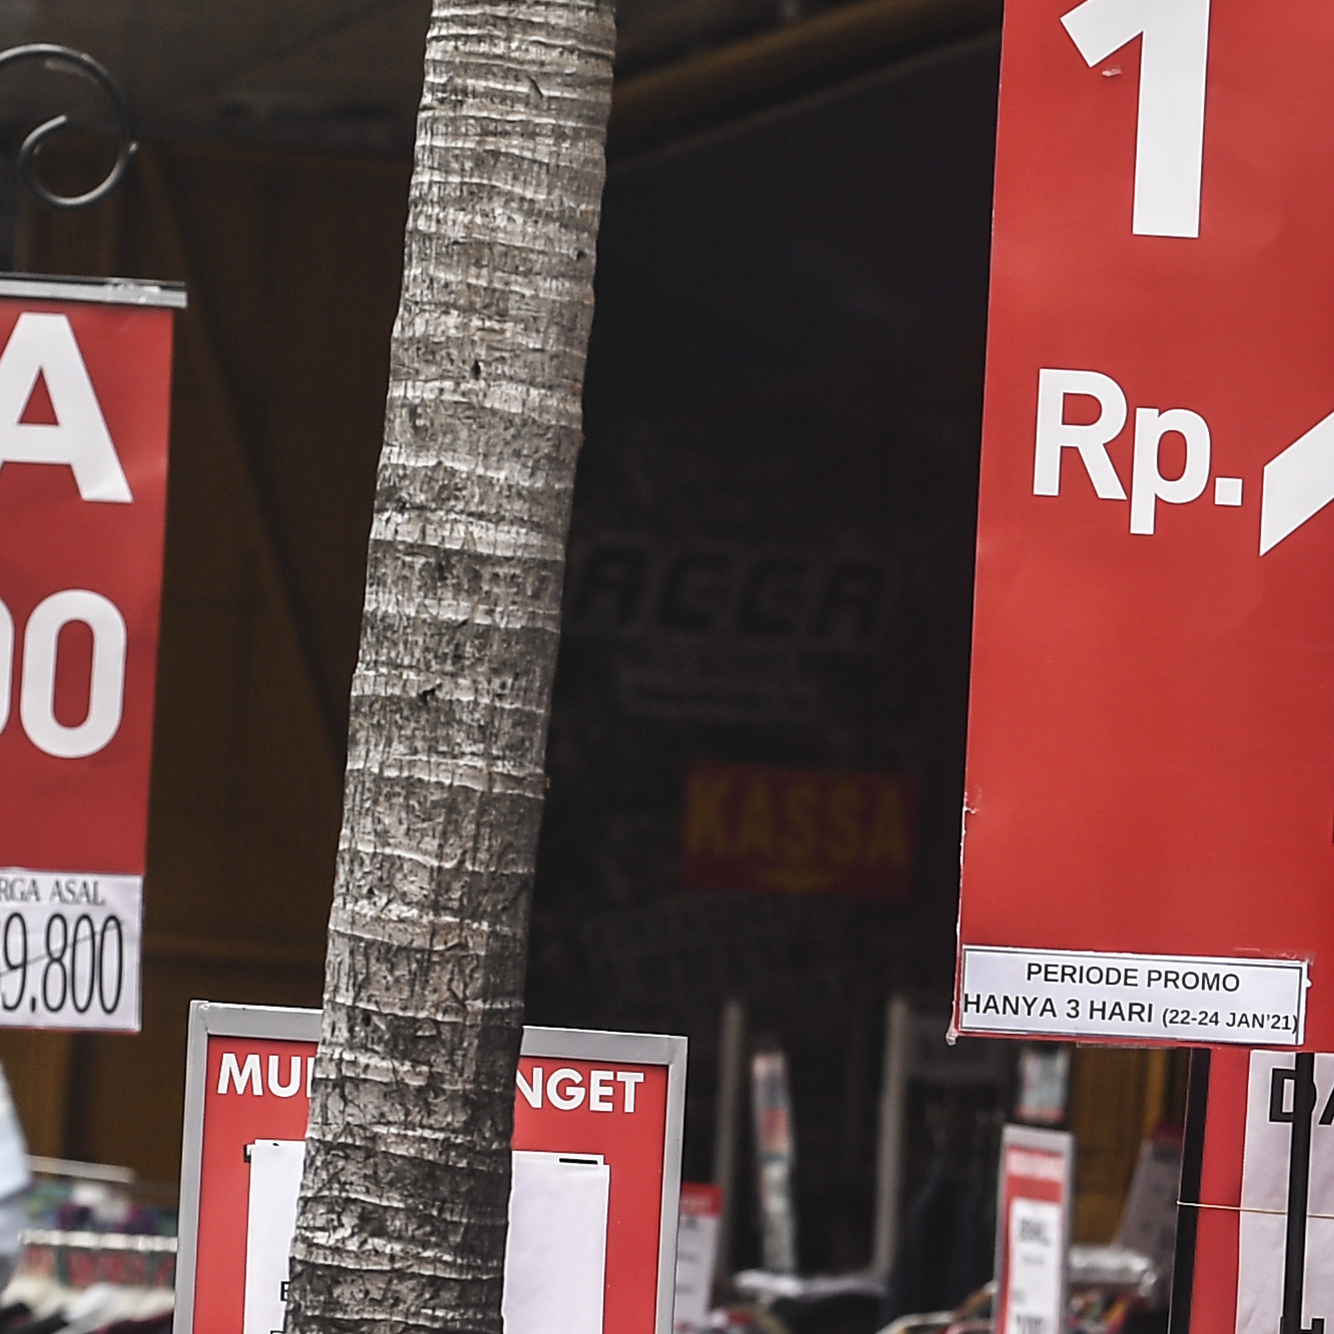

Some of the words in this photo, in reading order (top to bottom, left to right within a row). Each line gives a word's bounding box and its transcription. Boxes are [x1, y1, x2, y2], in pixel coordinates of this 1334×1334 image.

[1061, 0, 1210, 239] 1
[1034, 369, 1242, 534] Rp.
[687, 774, 914, 870] KASSA
[50, 880, 107, 906] ASAL
[1026, 962, 1139, 988] PERIODE
[1148, 969, 1240, 993] PROMO
[963, 994, 1058, 1021] HANYA
[1066, 998, 1080, 1019] 3
[1089, 999, 1153, 1023] HARI
[1162, 1006, 1221, 1030] (22-24
[217, 1053, 315, 1098] MU
